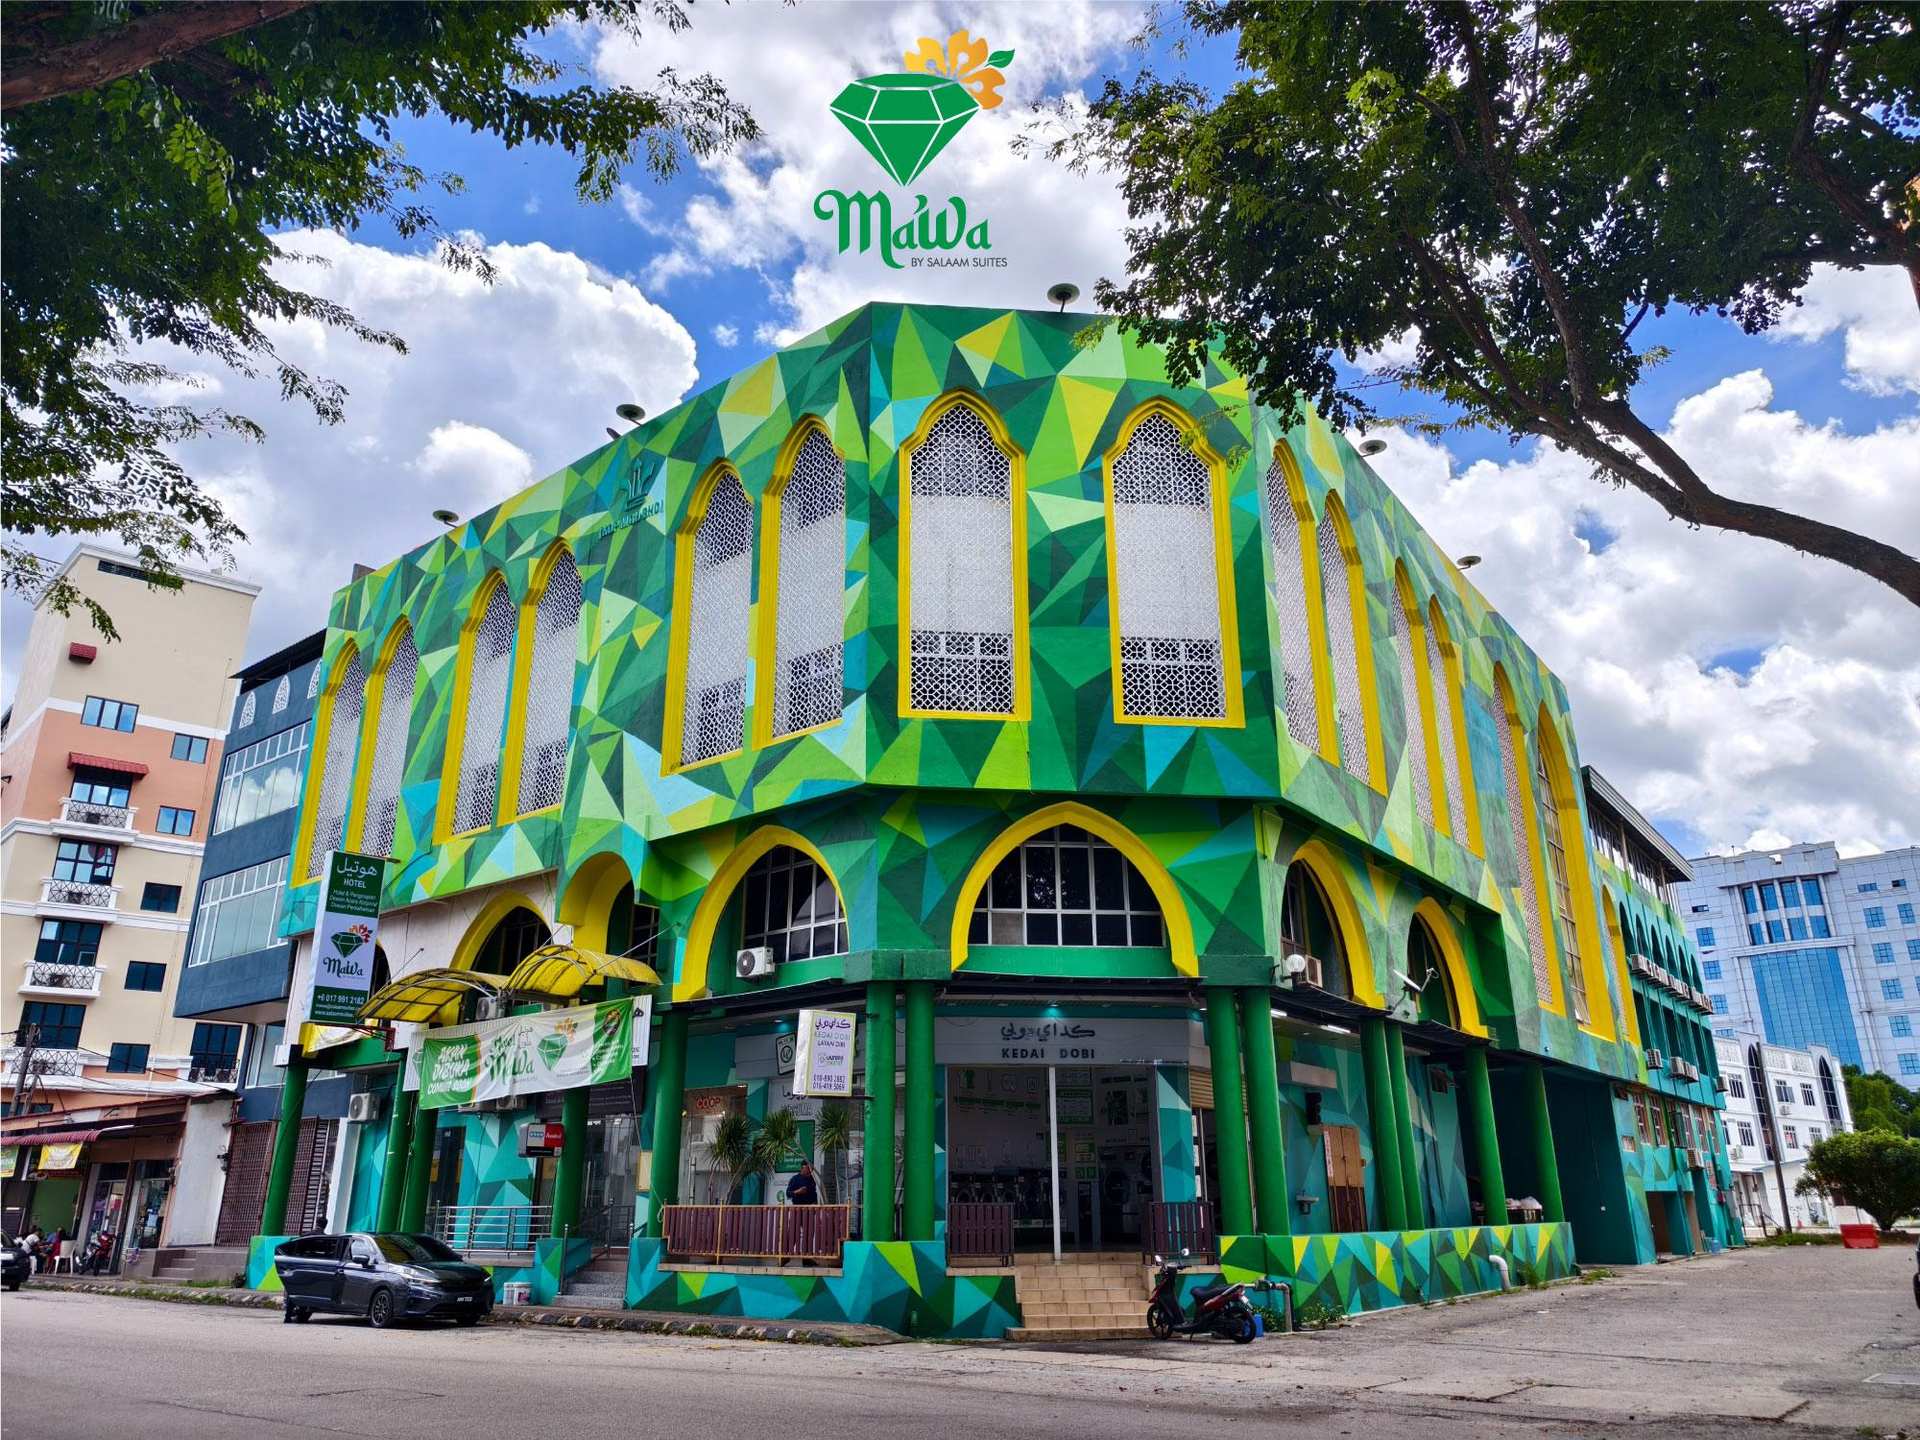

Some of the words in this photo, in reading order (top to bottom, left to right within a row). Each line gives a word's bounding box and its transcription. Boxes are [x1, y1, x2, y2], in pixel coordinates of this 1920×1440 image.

[344, 878, 367, 889] HOTEL
[1001, 1048, 1045, 1059] KEDAI
[1060, 1048, 1095, 1059] DOBI
